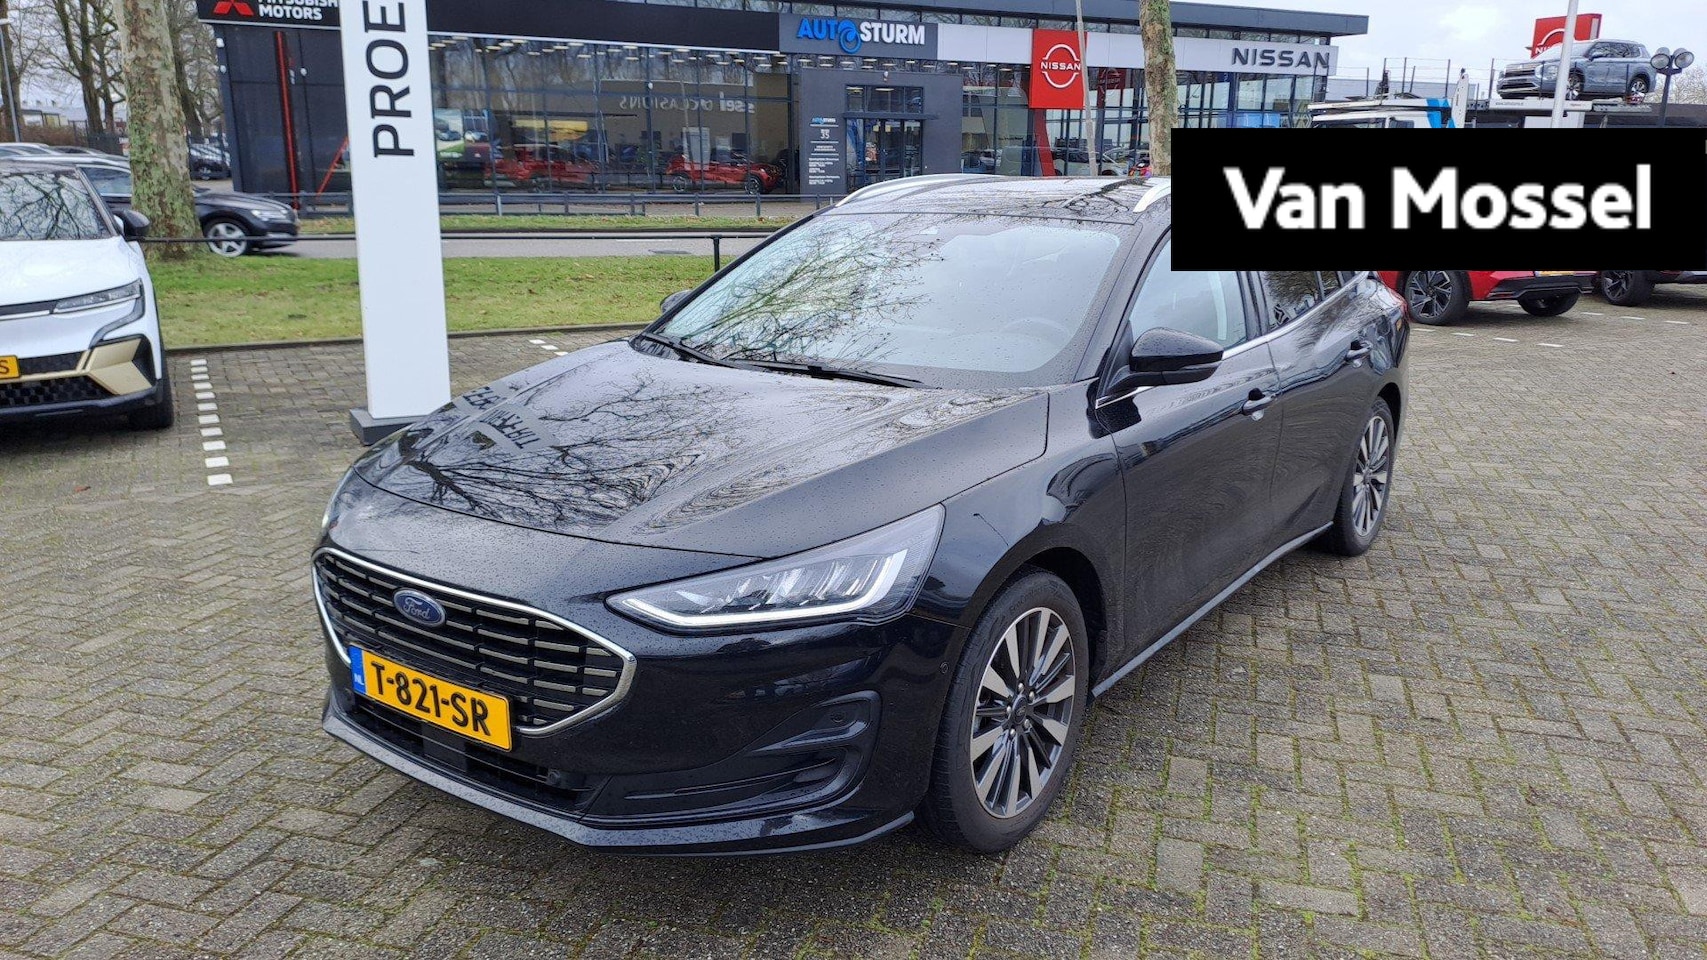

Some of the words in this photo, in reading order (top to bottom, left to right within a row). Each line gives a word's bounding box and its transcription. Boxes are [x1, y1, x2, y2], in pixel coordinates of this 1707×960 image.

[258, 4, 323, 21] MOTORS
[1040, 61, 1081, 71] NISSAN
[1231, 46, 1330, 69] NISSAN
[362, 0, 415, 158] PROE
[402, 597, 433, 621] Ford
[353, 674, 365, 687] NL
[370, 660, 491, 737] T-821-SR
